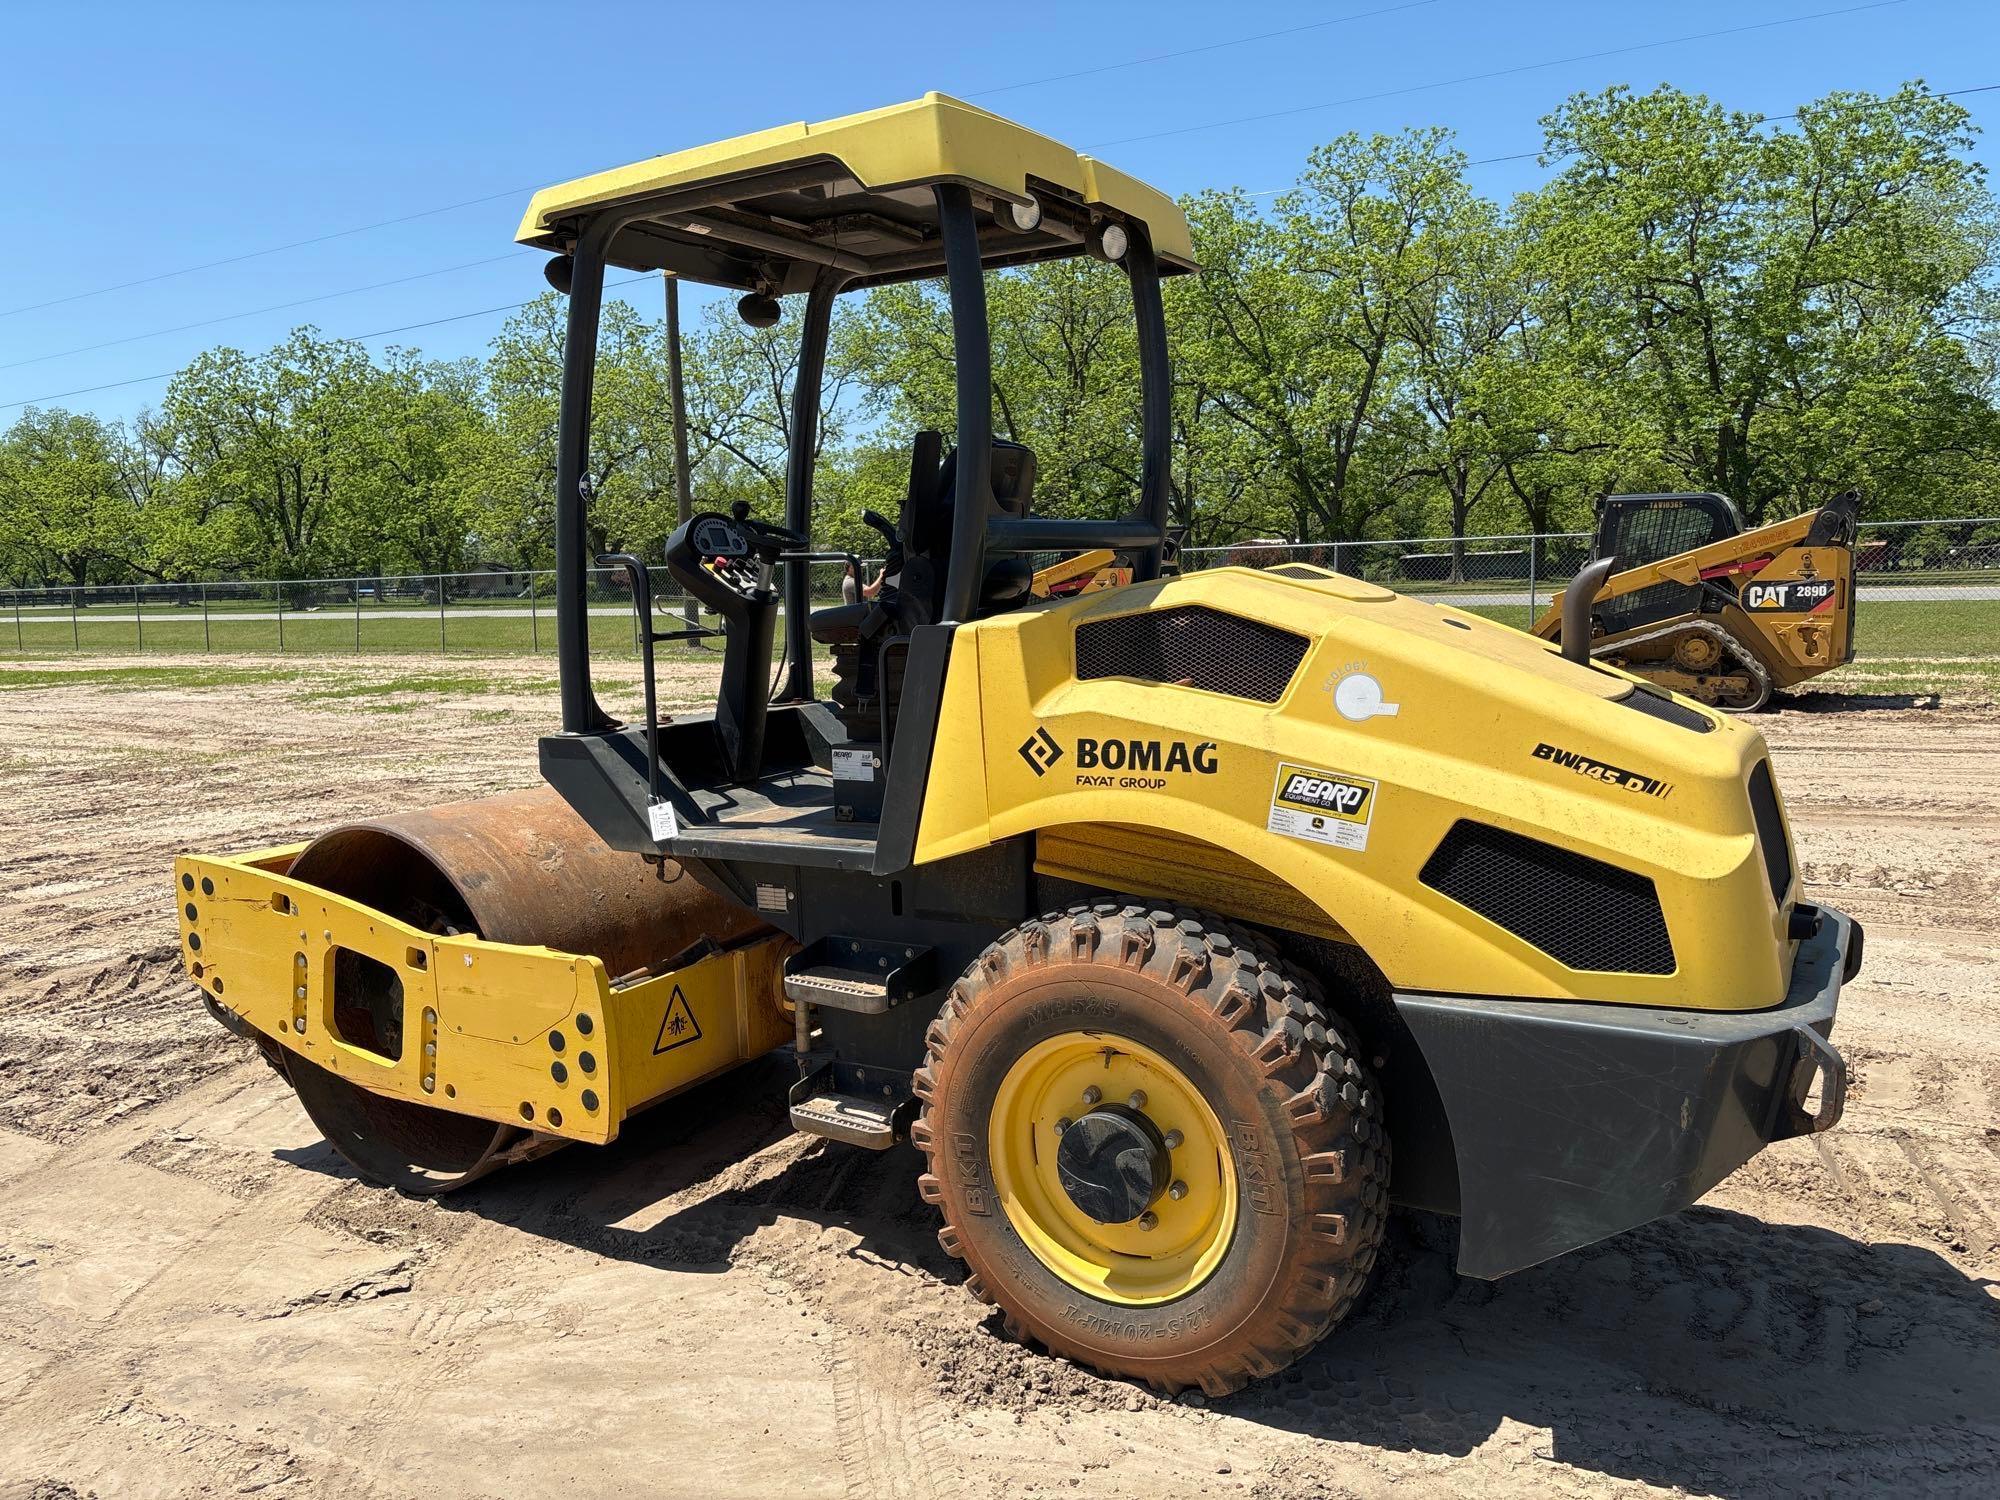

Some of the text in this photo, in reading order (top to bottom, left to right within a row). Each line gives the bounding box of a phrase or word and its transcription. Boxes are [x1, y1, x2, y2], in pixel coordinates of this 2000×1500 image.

[1749, 586, 1827, 608] CAT 289D
[1322, 660, 1369, 693] ECOLOGY
[1077, 738, 1218, 774] BOMAG
[1076, 775, 1166, 789] FAYAT GROUP
[1284, 792, 1320, 805] EQUIPMENT
[1287, 775, 1363, 813] BEARD
[1024, 996, 1120, 1027] MP 585
[951, 1134, 989, 1215] BKT
[1235, 1122, 1280, 1214] BKT
